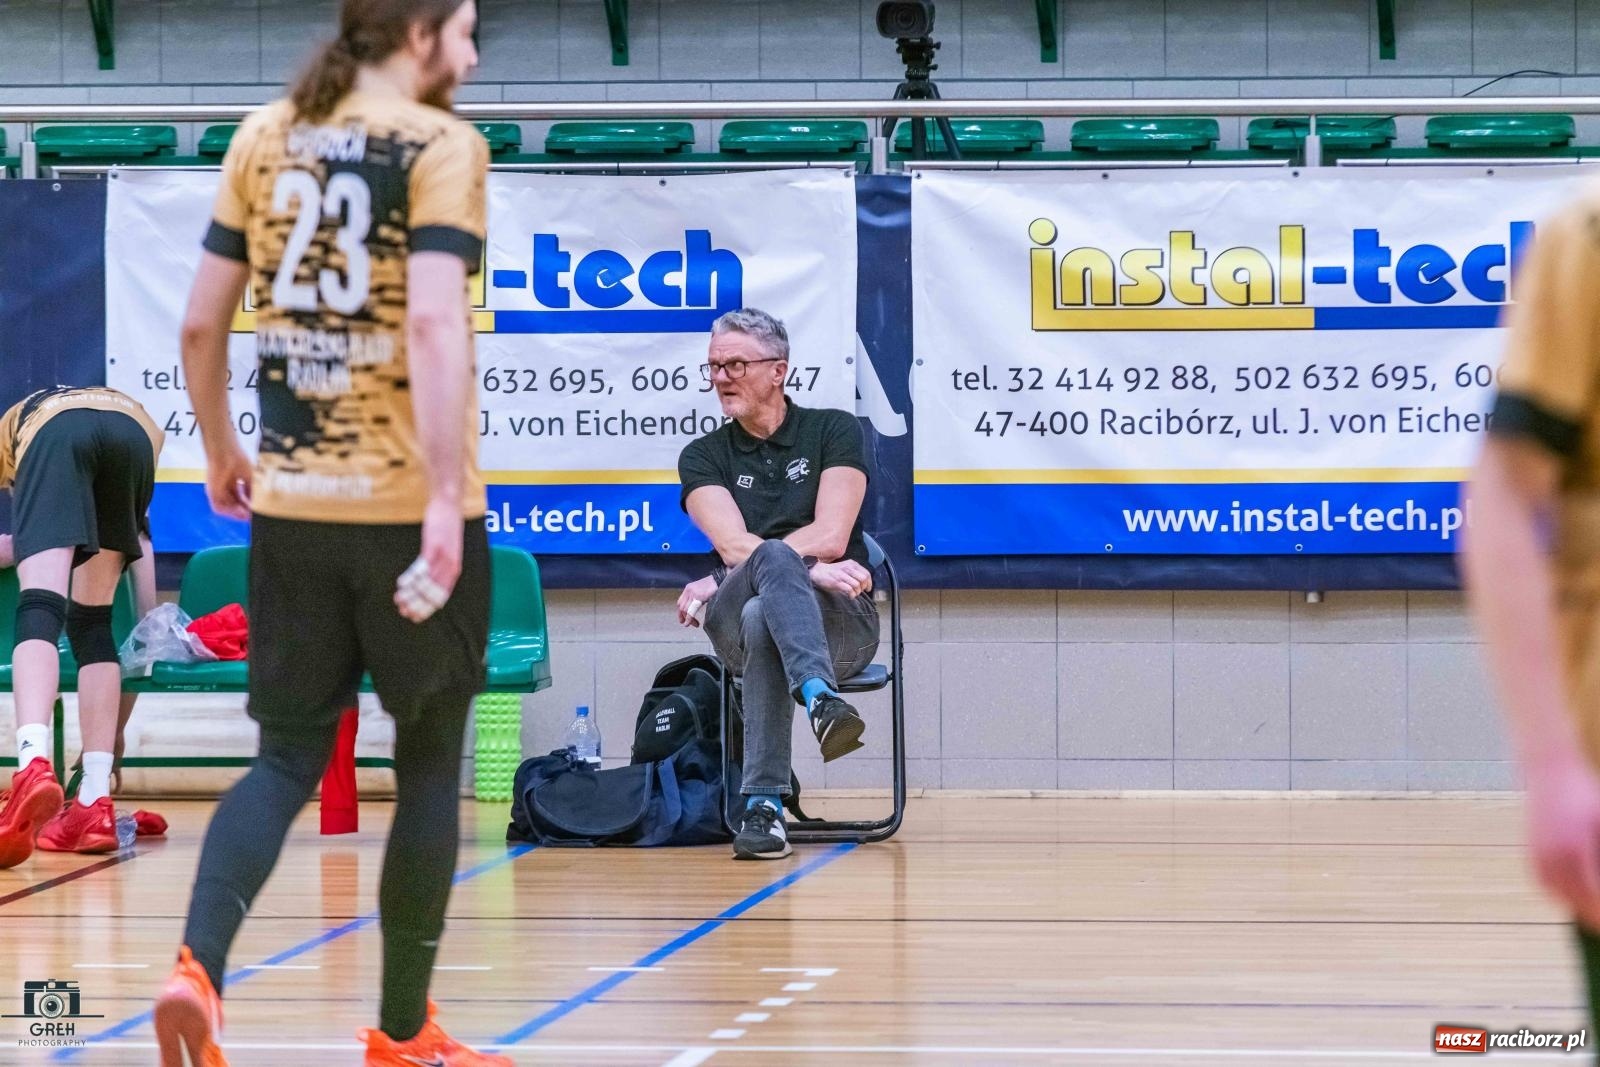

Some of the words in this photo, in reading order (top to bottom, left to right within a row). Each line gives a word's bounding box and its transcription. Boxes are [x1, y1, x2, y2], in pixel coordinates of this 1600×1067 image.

[272, 170, 371, 315] 23
[142, 365, 187, 391] tel.
[482, 366, 538, 394] 632
[549, 366, 614, 395] 695,
[631, 365, 689, 392] 606
[784, 366, 822, 392] 47
[951, 365, 998, 391] tel.
[1008, 367, 1044, 392] 32
[1055, 367, 1114, 392] 414
[1123, 367, 1160, 393] 92
[1171, 365, 1217, 393] 88,
[1235, 366, 1291, 392] 502
[1303, 364, 1360, 390] 632
[1371, 363, 1437, 391] 695,
[479, 410, 498, 436] J.
[509, 416, 564, 436] von
[974, 411, 1089, 436] 47-400
[1100, 408, 1241, 438] Racibórz,
[1252, 407, 1288, 434] ul.
[1299, 407, 1318, 434] J.
[1329, 413, 1386, 434] von
